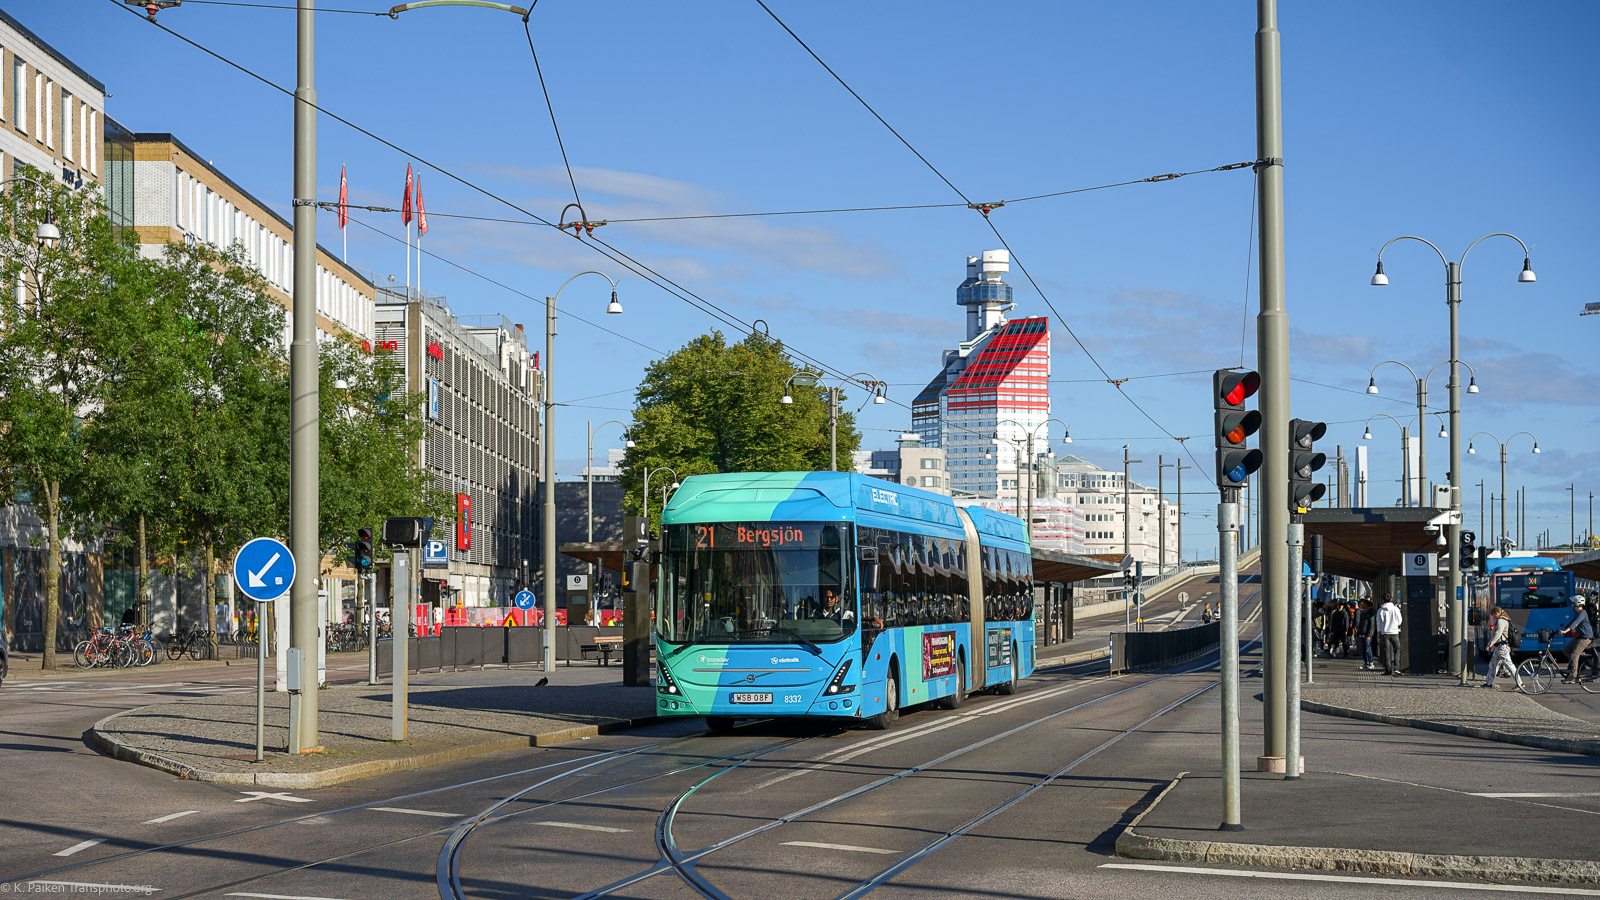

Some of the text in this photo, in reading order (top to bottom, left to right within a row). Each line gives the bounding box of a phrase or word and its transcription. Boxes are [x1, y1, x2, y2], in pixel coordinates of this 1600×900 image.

[872, 488, 898, 506] ELECTRIC
[697, 526, 803, 547] 21 Bergsjön
[1464, 533, 1471, 543] S
[430, 541, 443, 557] P
[784, 695, 802, 703] 8332
